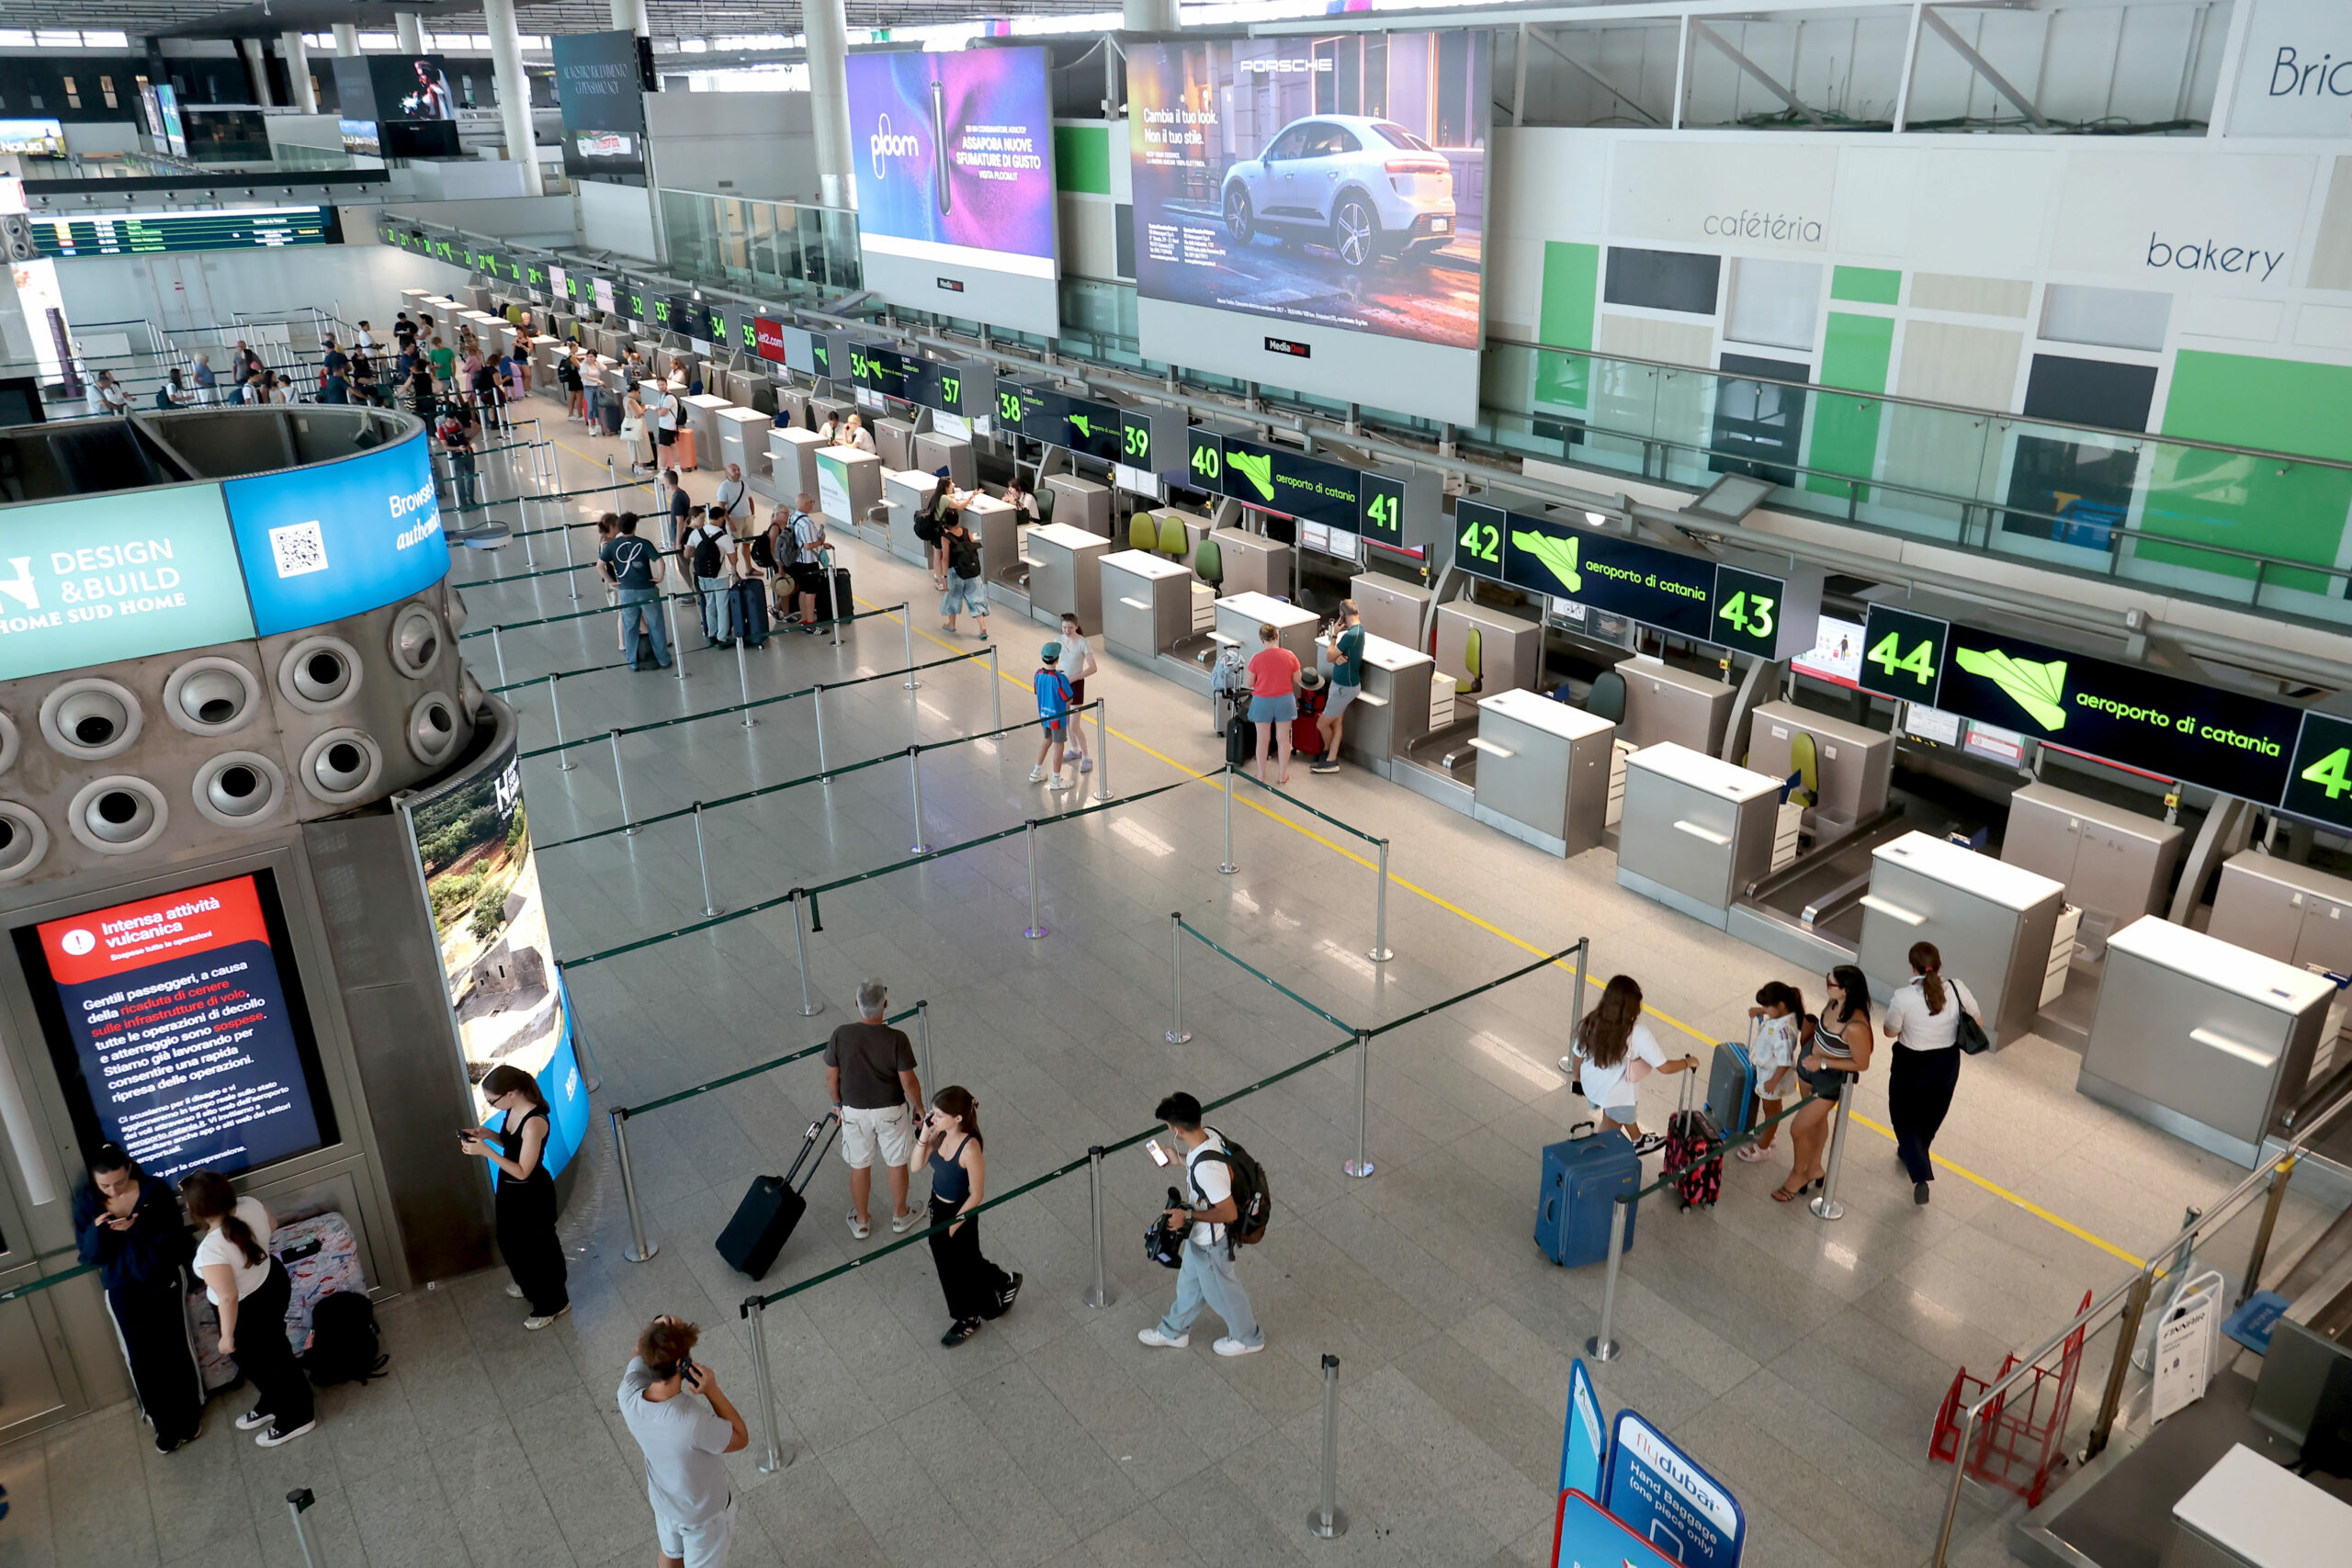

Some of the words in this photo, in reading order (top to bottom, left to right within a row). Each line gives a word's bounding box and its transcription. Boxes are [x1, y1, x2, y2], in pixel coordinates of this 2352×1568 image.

[1240, 58, 1333, 73] PORSCHE
[1144, 107, 1174, 123] Cambia
[1176, 108, 1181, 123] il
[1182, 110, 1196, 124] tuo
[1198, 108, 1218, 124] look.
[962, 137, 1003, 151] ASSAPORA
[1004, 138, 1033, 152] NUOVE
[1145, 128, 1160, 142] Non
[1162, 129, 1167, 143] il
[1169, 130, 1183, 144] tuo
[1184, 130, 1204, 144] stile.
[956, 152, 1001, 166] SFUMATURE
[1002, 154, 1012, 167] DI
[1012, 154, 1041, 169] GUSTO
[1704, 209, 1823, 243] cafétéria
[2146, 231, 2285, 283] bakery
[566, 278, 577, 296] 30
[585, 283, 595, 301] 31
[631, 296, 643, 315] 32
[654, 301, 667, 321] 33
[711, 316, 727, 339] 34
[742, 324, 756, 347] 35
[758, 332, 784, 347] Jet2.com
[851, 353, 868, 378] 36
[942, 377, 959, 404] 37
[1000, 392, 1022, 423] 38
[1125, 425, 1148, 457] 39
[1192, 446, 1219, 479] 40
[389, 482, 431, 518] Browse
[1276, 473, 1314, 491] aeroporto
[1316, 482, 1323, 493] di
[1324, 485, 1355, 502] catania
[1367, 493, 1397, 531] 41
[51, 538, 174, 575] DESIGN
[1460, 521, 1499, 563] 42
[62, 567, 180, 603] &BUILD
[1586, 559, 1642, 584] aeroporto
[1645, 573, 1657, 588] di
[1659, 579, 1706, 602] catania
[67, 604, 113, 623] SUD
[119, 592, 187, 615] HOME
[1719, 591, 1775, 638] 43
[1867, 631, 1935, 686] 44
[2075, 691, 2171, 728] aeroporto
[2176, 715, 2195, 735] di
[2200, 722, 2280, 759] catania
[2301, 747, 2352, 800] 4
[101, 912, 164, 935] Intensa
[166, 897, 220, 920] attività
[106, 921, 184, 948] vulcanica
[110, 948, 144, 961] Sospese
[145, 942, 164, 953] tutte
[174, 931, 212, 946] operazioni
[83, 992, 125, 1010] Gentili
[127, 974, 199, 1003] passeggeri,
[200, 972, 209, 981] a
[210, 962, 248, 977] causa
[87, 1009, 119, 1024] della
[120, 995, 173, 1016] ricaduta
[174, 990, 187, 1001] di
[188, 980, 230, 998] cenere
[91, 1022, 122, 1038] sulle
[124, 999, 205, 1030] infrastrutture
[207, 996, 219, 1007] di
[220, 988, 250, 1003] volo,
[95, 1035, 126, 1051] tutte
[127, 1032, 141, 1042] le
[142, 1012, 207, 1039] operazioni
[209, 1009, 220, 1021] di
[222, 998, 266, 1017] decollo
[99, 1055, 109, 1064] e
[111, 1036, 179, 1062] atterraggio
[181, 1027, 212, 1042] sono
[213, 1012, 267, 1033] sospese.
[104, 1058, 150, 1077] Stiamo
[151, 1052, 171, 1069] già
[172, 1034, 232, 1058] lavorando
[234, 1027, 254, 1043] per
[107, 1065, 174, 1089] consentire
[175, 1057, 199, 1071] una
[200, 1046, 239, 1066] rapida
[112, 1082, 155, 1103] ripresa
[157, 1074, 187, 1089] delle
[188, 1055, 254, 1081] operazioni.
[118, 1115, 129, 1124] Ci
[130, 1104, 169, 1122] scusiamo
[171, 1101, 185, 1111] per
[192, 1089, 221, 1104] disagio
[188, 1100, 216, 1113] tempo
[216, 1094, 236, 1104] reale
[237, 1089, 256, 1100] sullo
[256, 1081, 277, 1092] stato
[123, 1132, 138, 1141] dei
[139, 1127, 153, 1136] voli
[154, 1115, 195, 1133] attraverso
[202, 1107, 218, 1117] sito
[218, 1102, 236, 1112] web
[129, 1139, 173, 1157] consultare
[174, 1132, 198, 1144] anche
[199, 1126, 215, 1138] app
[222, 1121, 235, 1130] siti
[235, 1115, 253, 1125] web
[253, 1111, 266, 1121] dei
[266, 1102, 291, 1116] vettori
[208, 1116, 217, 1124] Vi
[218, 1106, 254, 1122] invitiamo
[136, 1145, 184, 1164] eroportuali.
[165, 1167, 178, 1177] per
[179, 1163, 187, 1171] la
[188, 1145, 247, 1168] comprensione.
[1635, 1432, 1715, 1512] flydubai
[1629, 1475, 1653, 1503] (one
[1655, 1498, 1685, 1530] piece
[1687, 1527, 1713, 1558] only)
[1630, 1460, 1662, 1494] Hand
[1663, 1485, 1717, 1544] Baggage
